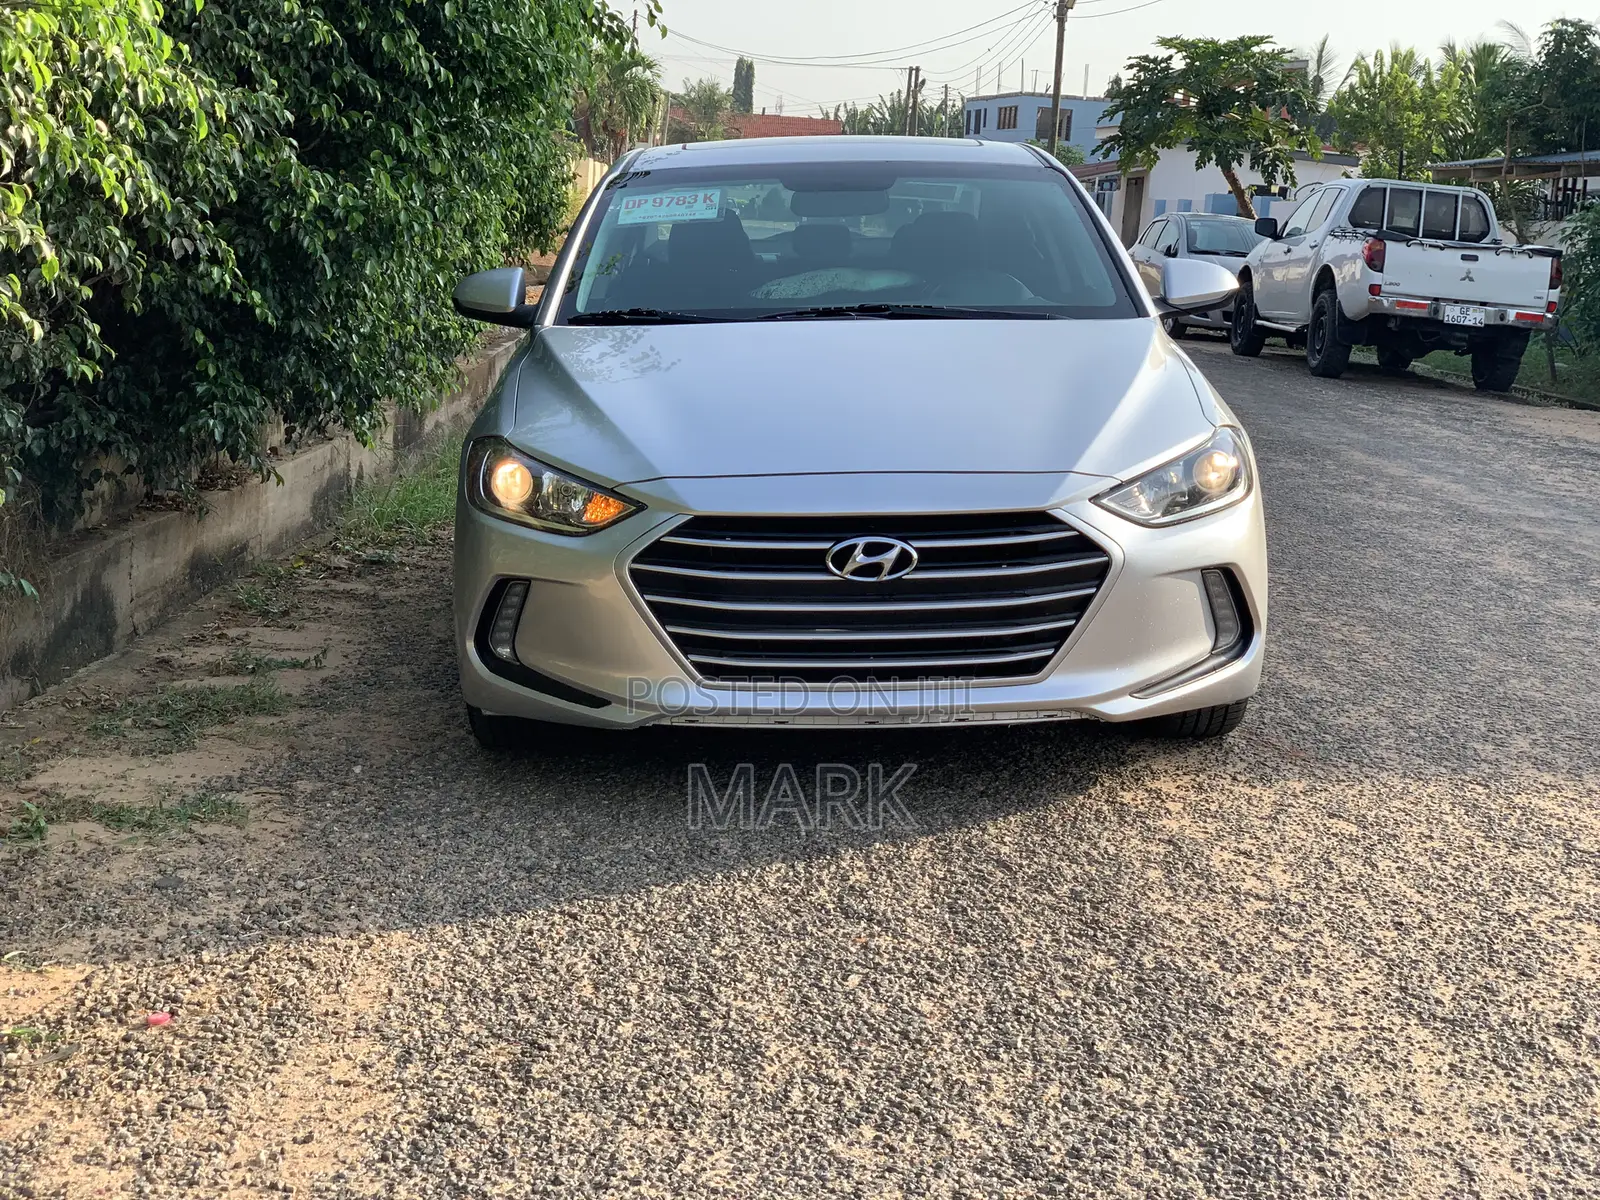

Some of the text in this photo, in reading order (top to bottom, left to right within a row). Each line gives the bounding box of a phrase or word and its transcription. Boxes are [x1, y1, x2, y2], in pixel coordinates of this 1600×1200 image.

[624, 199, 648, 210] DP
[652, 193, 699, 208] 9783
[703, 192, 715, 204] K
[1459, 306, 1471, 316] GE
[1445, 314, 1484, 326] 1607-14
